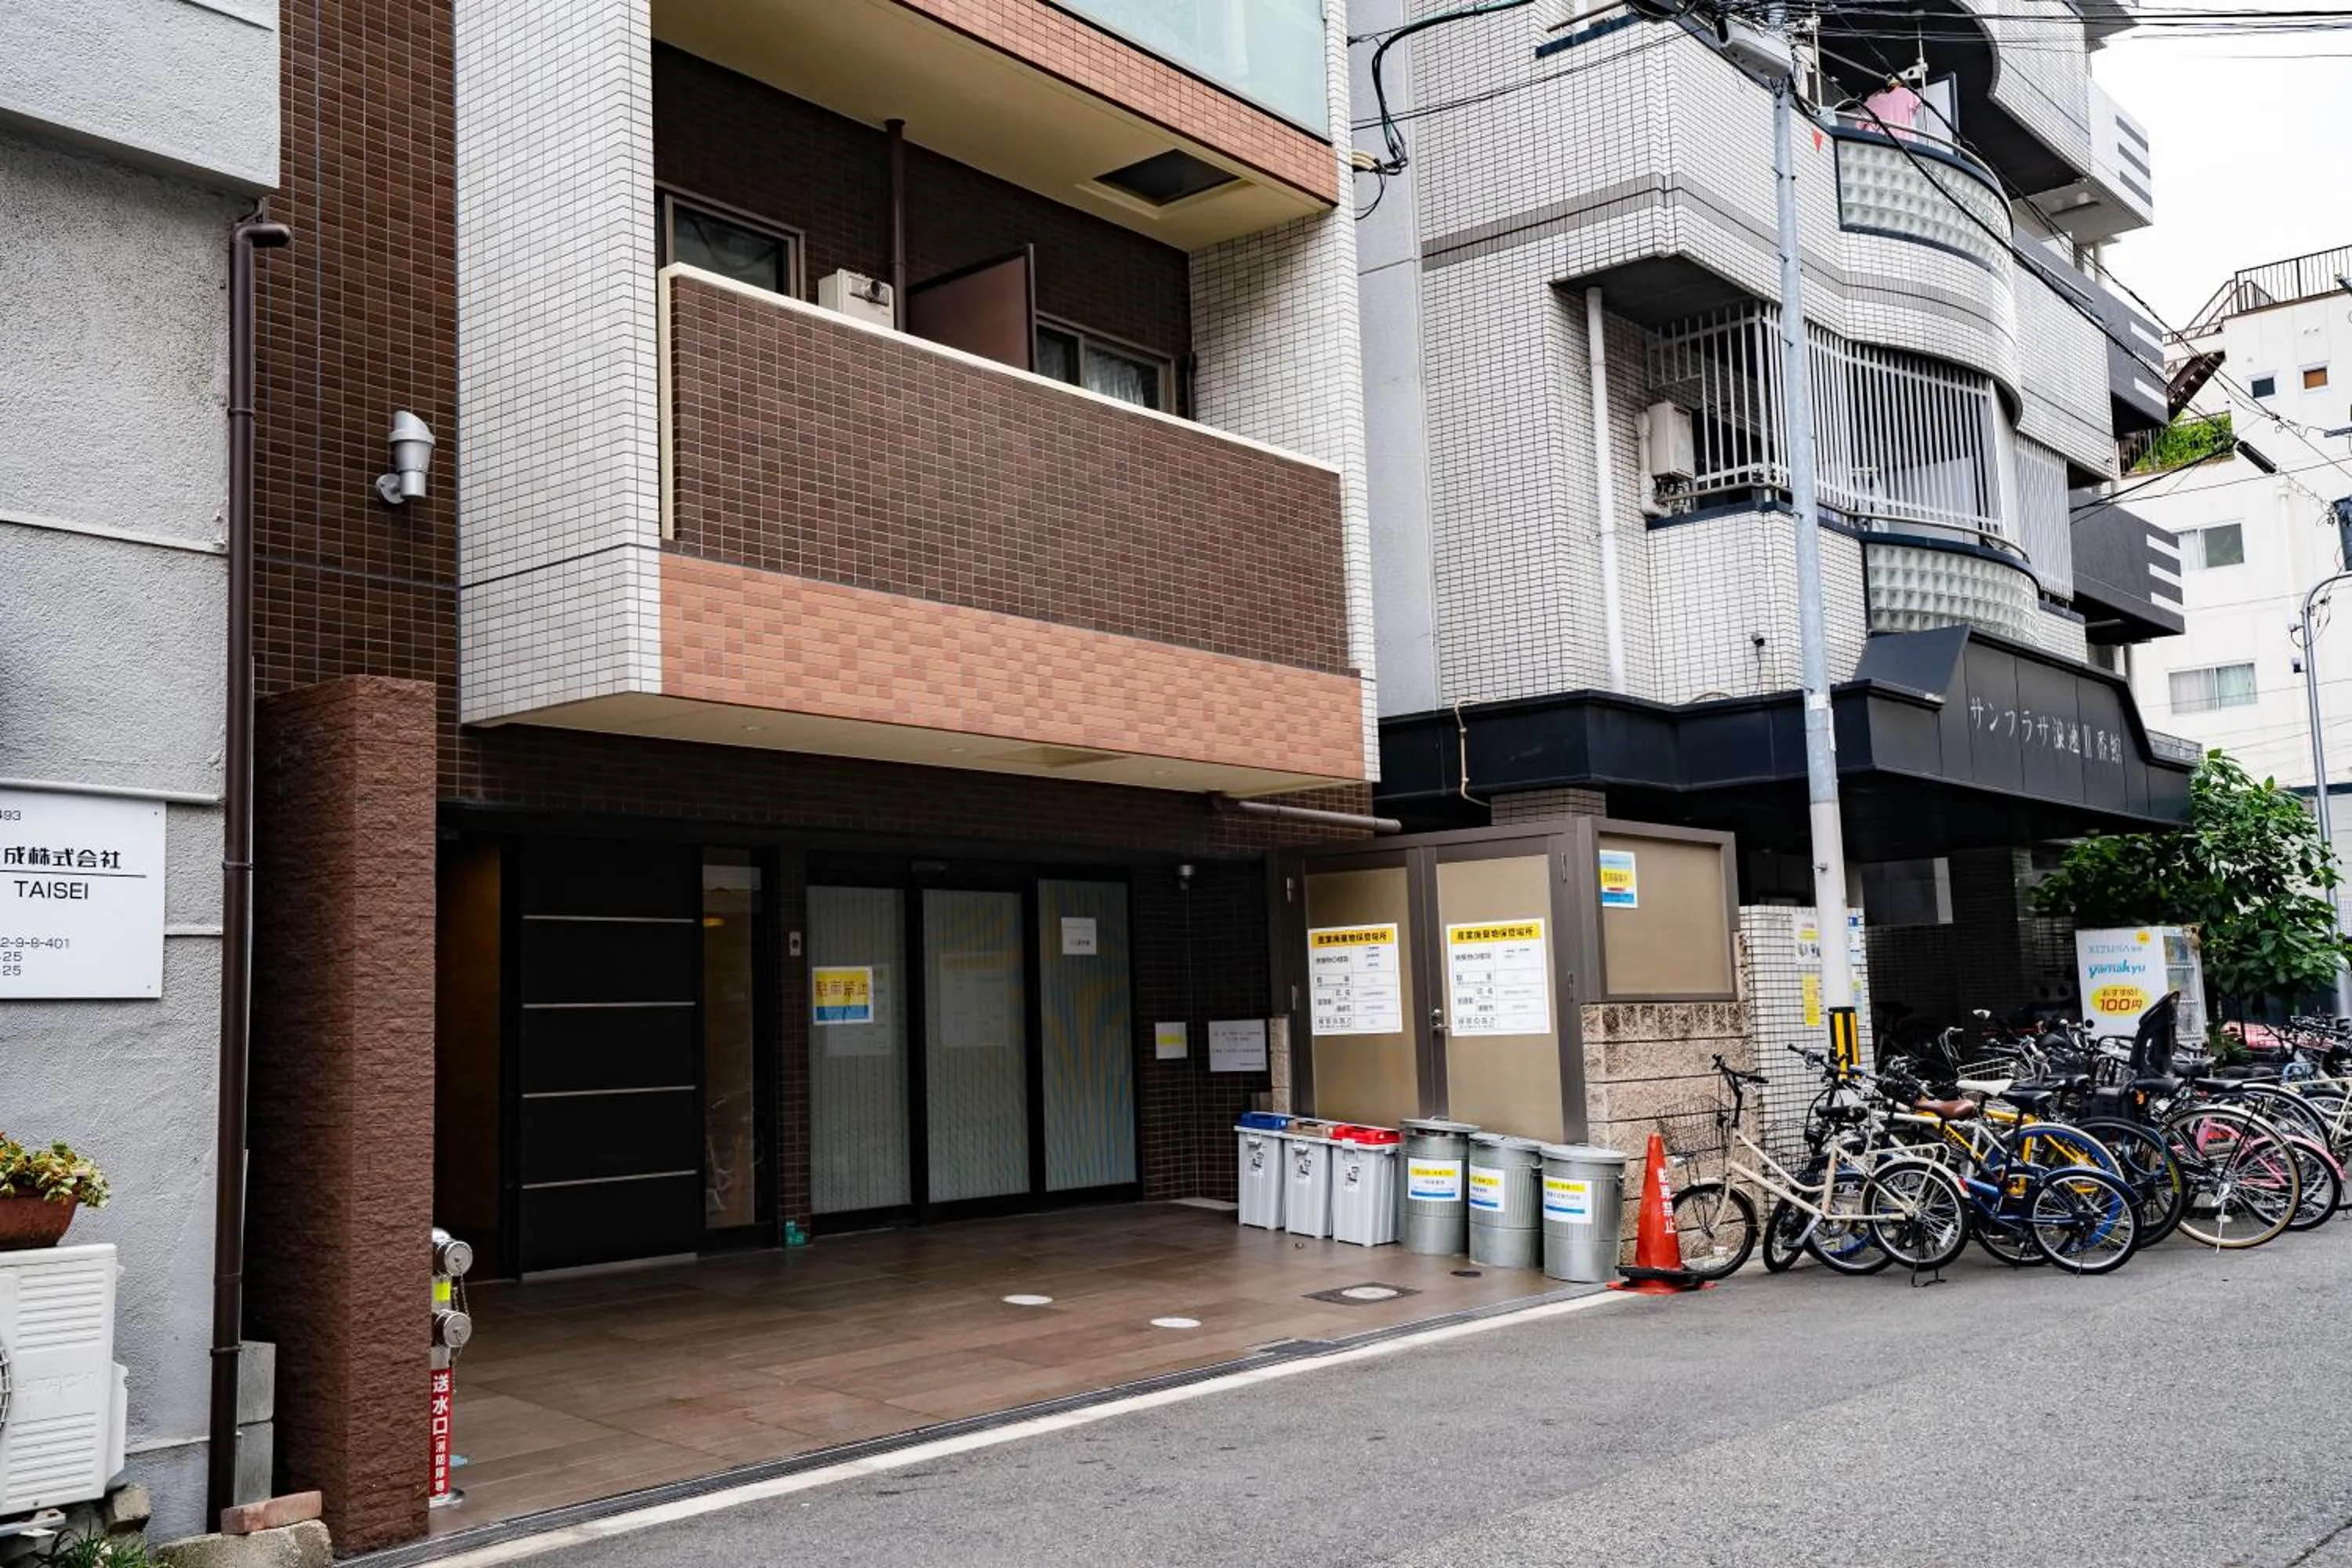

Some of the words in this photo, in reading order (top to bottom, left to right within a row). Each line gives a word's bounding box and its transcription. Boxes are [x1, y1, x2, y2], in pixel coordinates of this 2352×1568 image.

[3, 846, 122, 869] 成株式会社
[13, 880, 89, 899] TAISEI
[2100, 998, 2143, 1012] 100円
